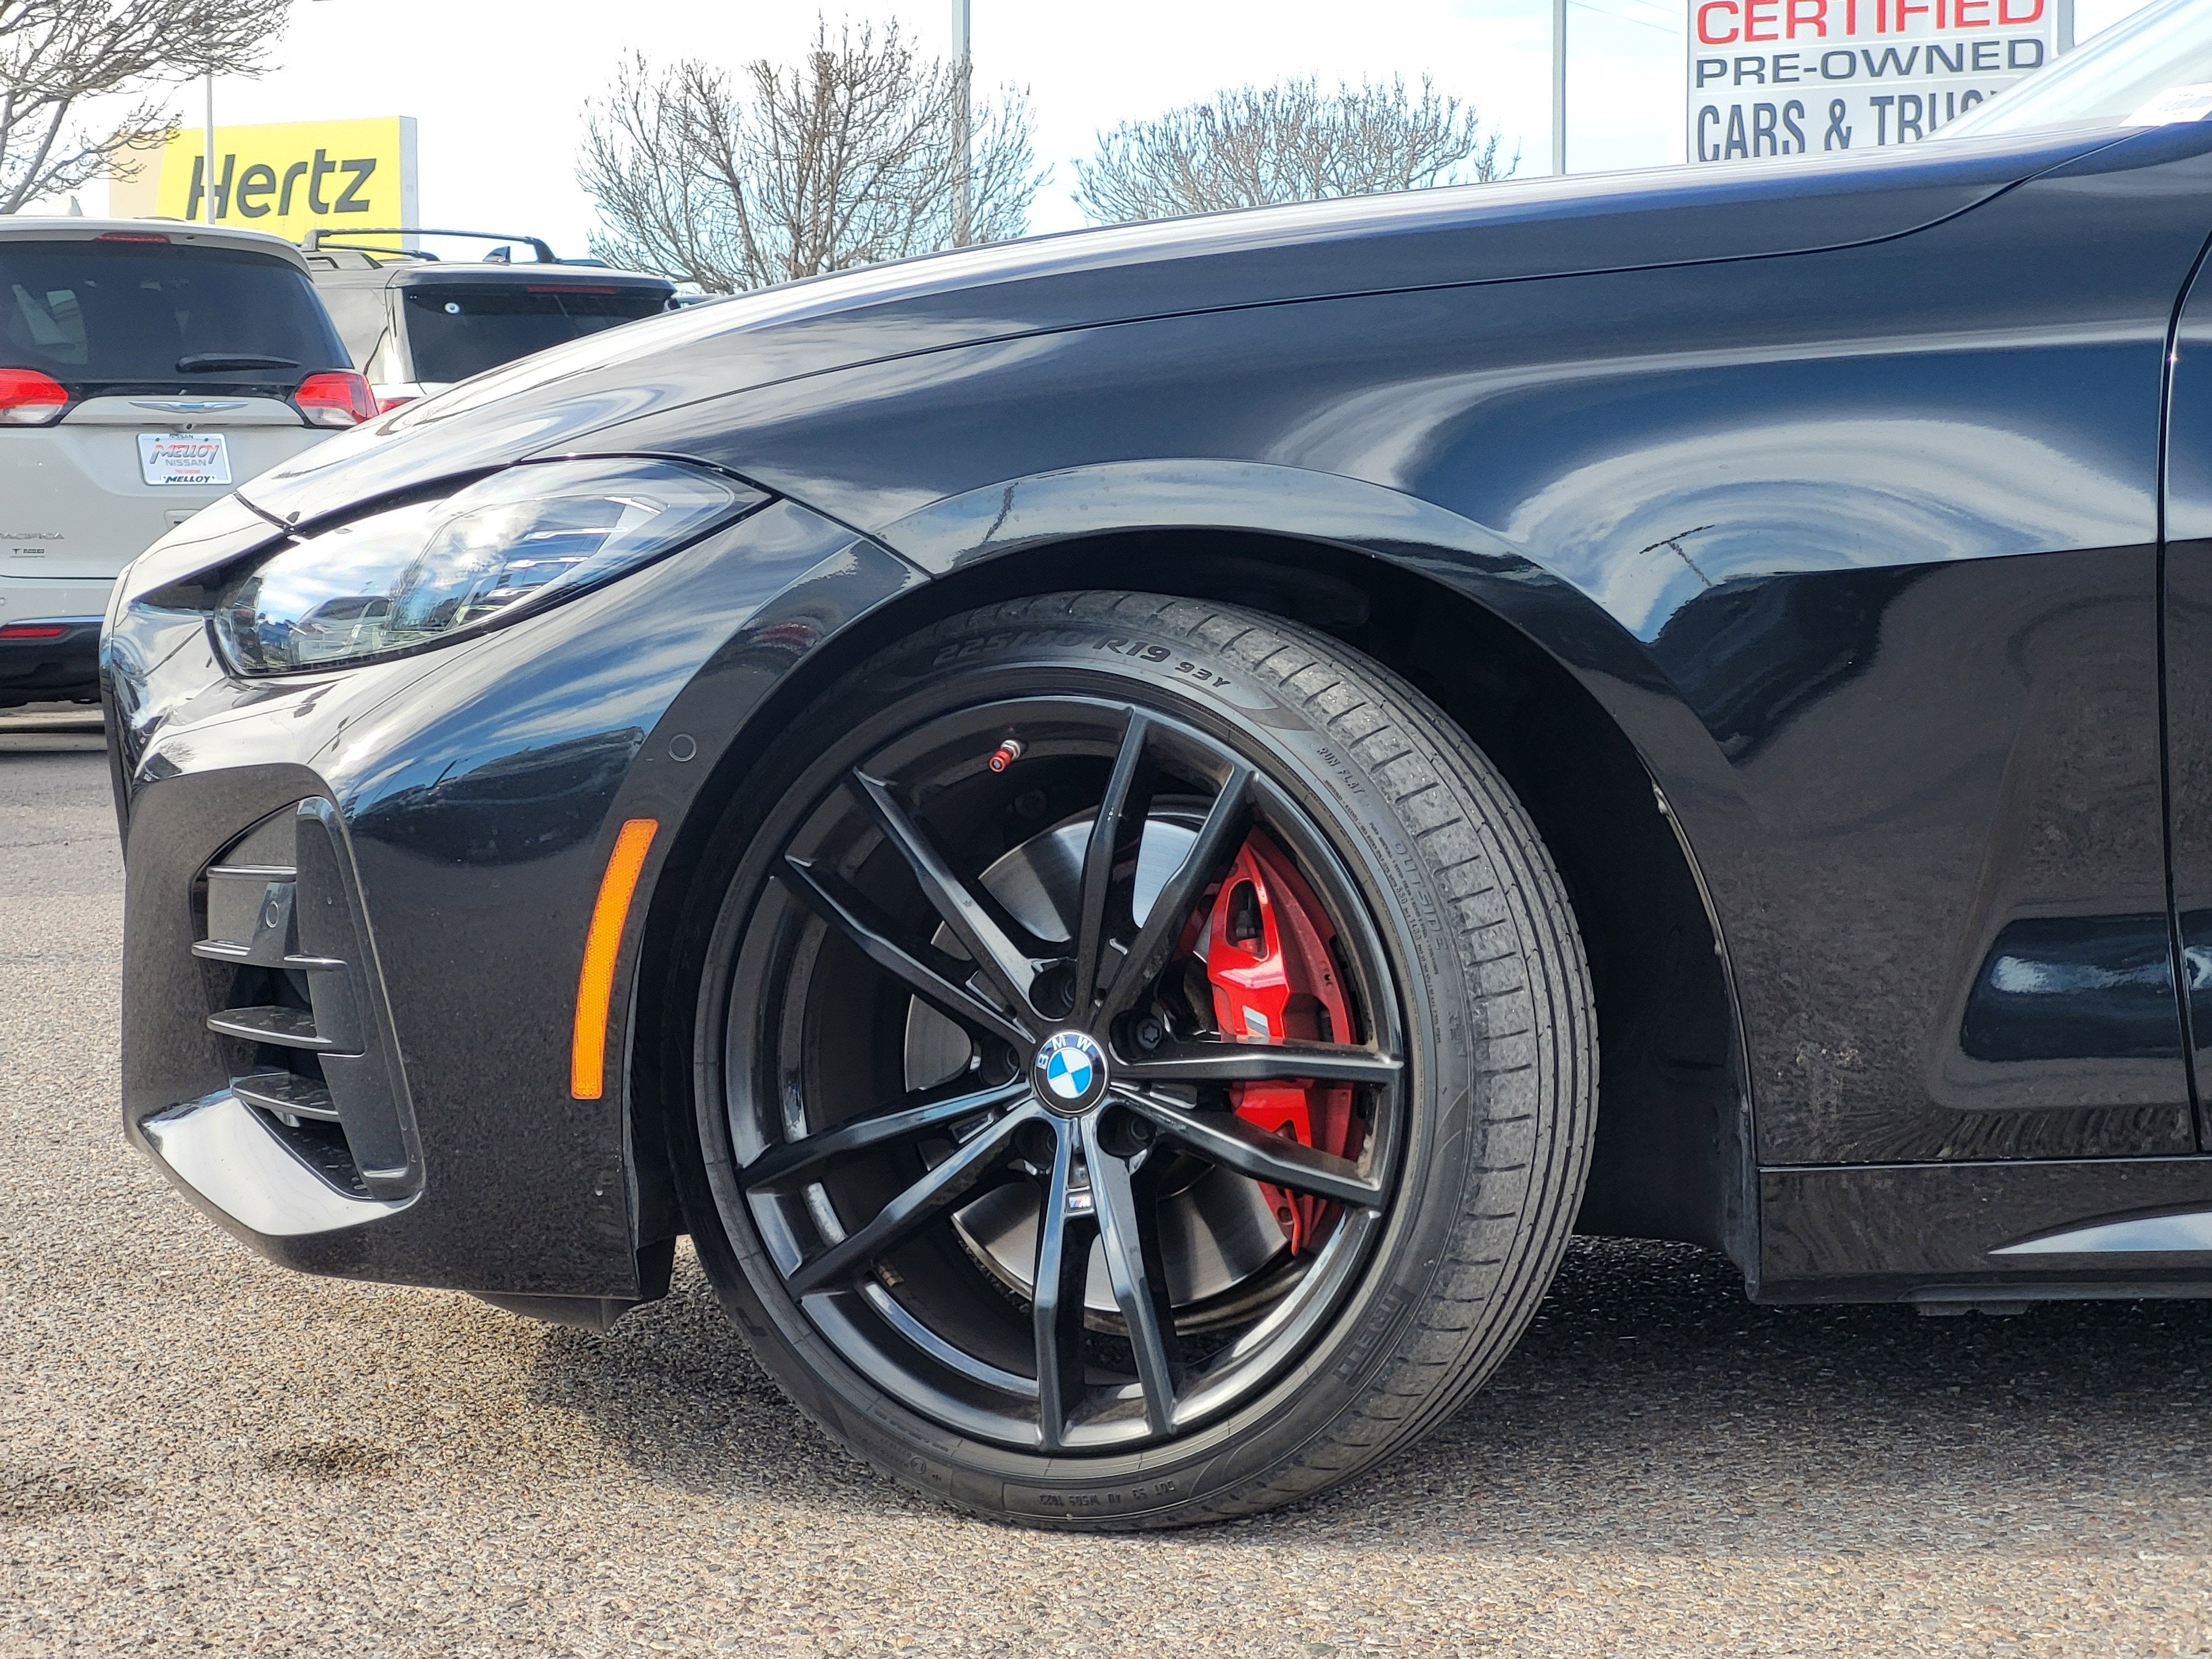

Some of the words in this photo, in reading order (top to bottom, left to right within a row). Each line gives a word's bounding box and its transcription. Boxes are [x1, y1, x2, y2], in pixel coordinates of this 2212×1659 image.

[1696, 0, 2045, 45] CERTIFIED
[1696, 39, 2044, 88] PRE-OWNED
[1698, 100, 1805, 162] CARS
[1825, 98, 1852, 150] &
[186, 149, 377, 220] Hertz
[149, 444, 219, 464] MELLOY
[1092, 637, 1171, 662] R19
[1180, 661, 1231, 687] 93Y
[1317, 747, 1340, 766] RUN
[1338, 769, 1365, 794] FLAT
[1036, 1035, 1093, 1070] BMW
